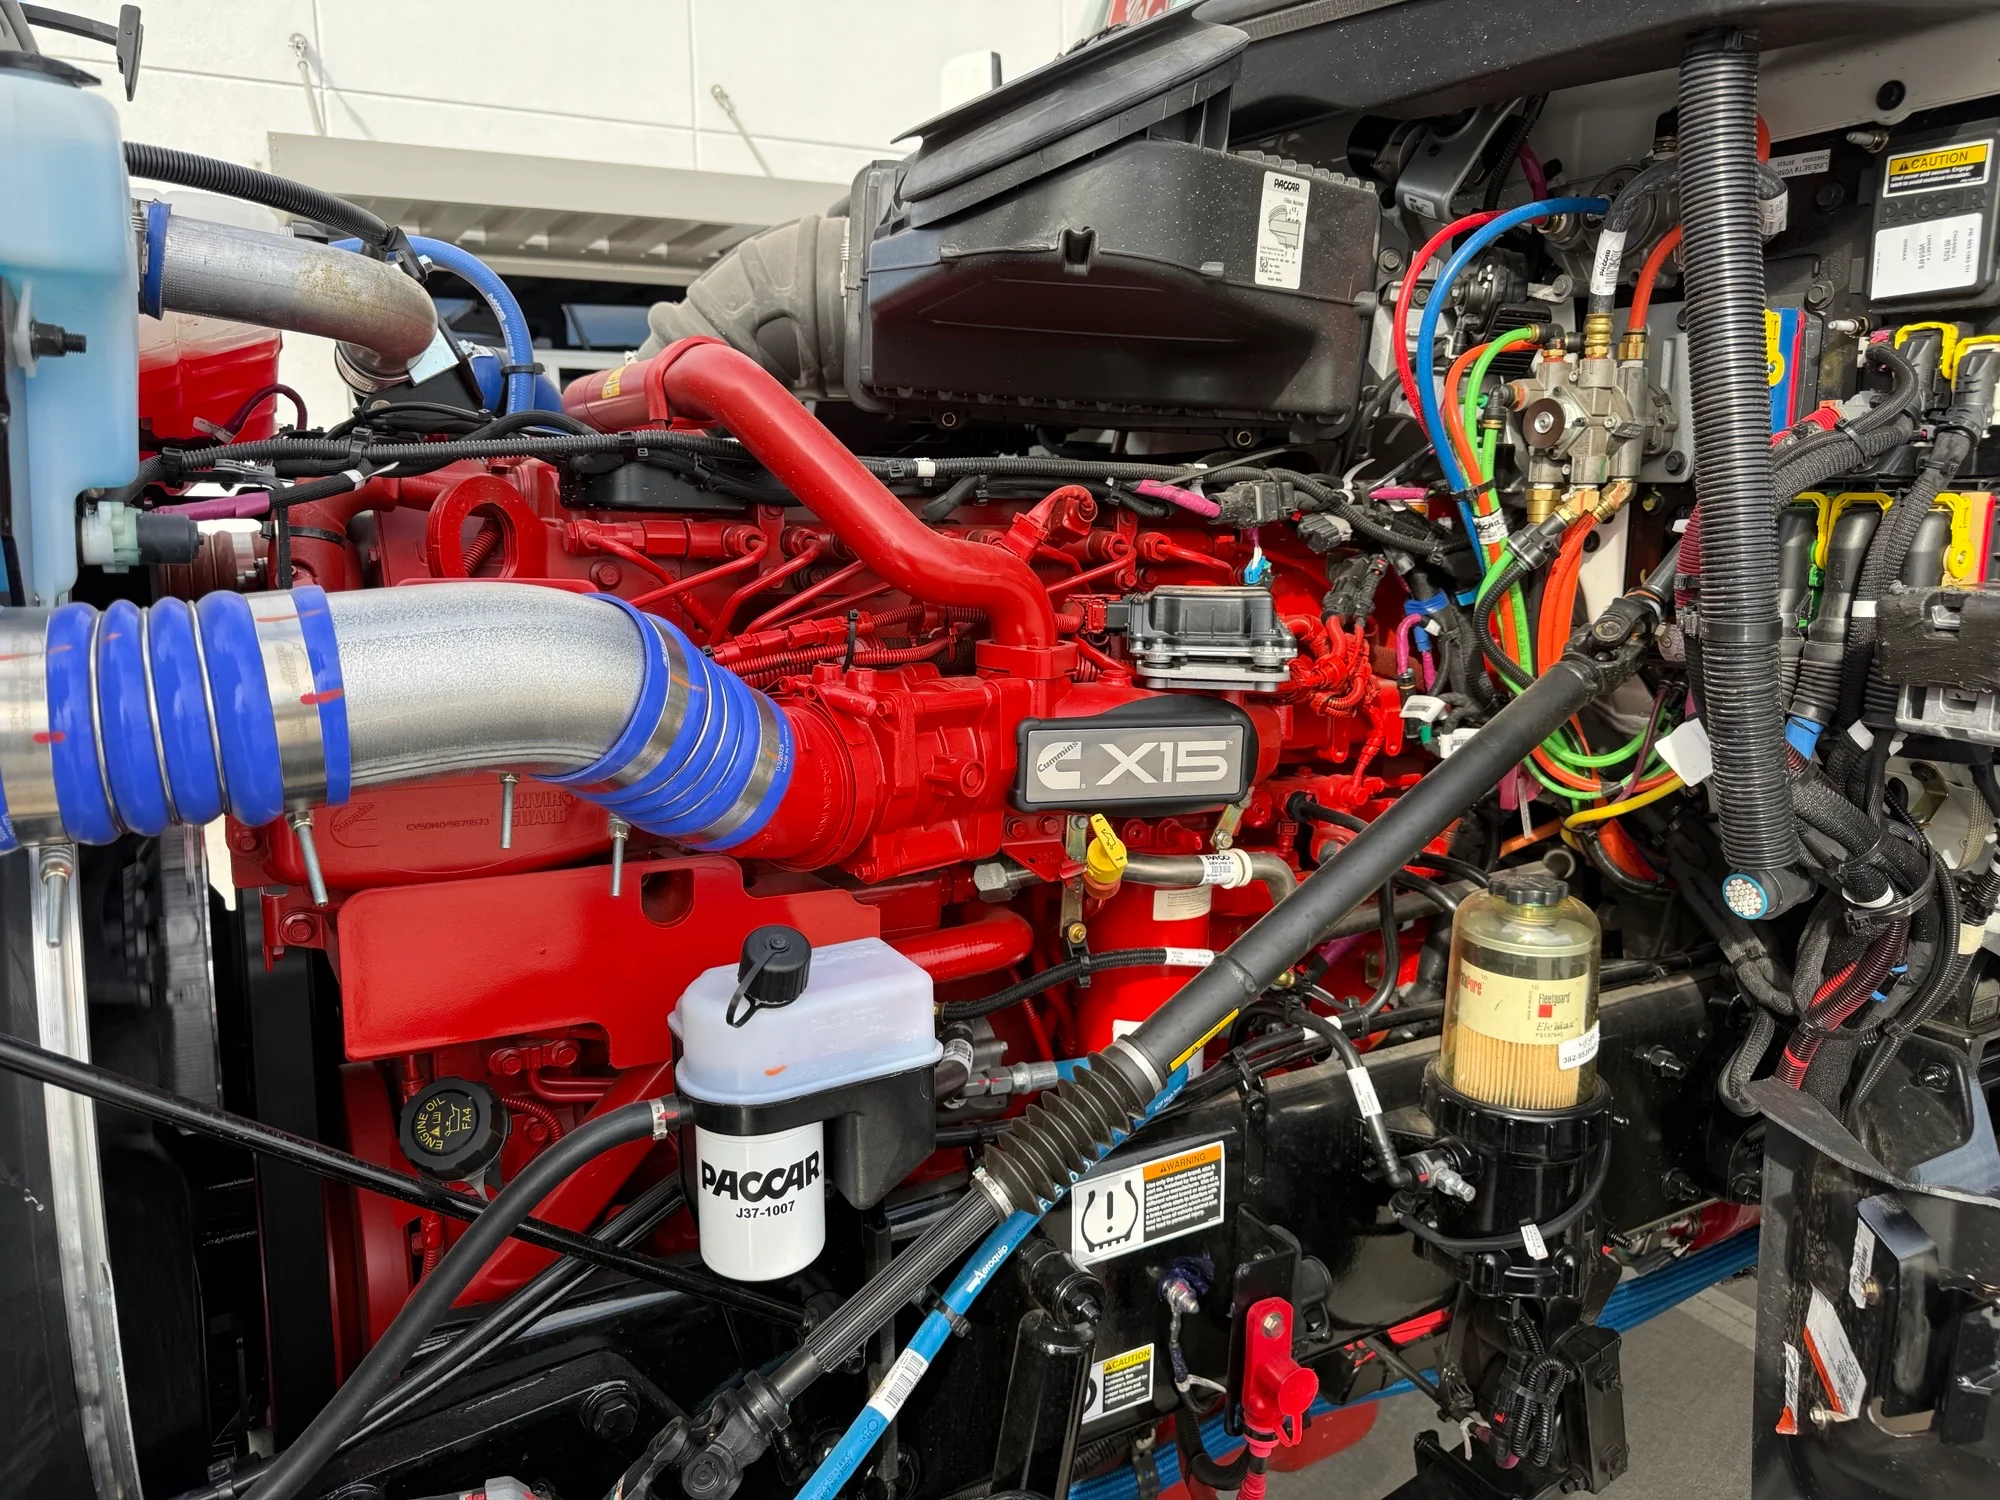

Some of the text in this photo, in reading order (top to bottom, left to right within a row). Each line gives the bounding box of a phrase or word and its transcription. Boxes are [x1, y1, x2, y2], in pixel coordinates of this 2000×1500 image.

[1911, 151, 1968, 169] CAUTION
[1273, 178, 1300, 193] PACCAR
[1880, 188, 1986, 223] PACCAR
[1599, 249, 1611, 276] PACCAR
[775, 743, 785, 772] 03/2025
[1037, 741, 1079, 773] Cummins
[1096, 740, 1228, 786] X15
[333, 803, 376, 833] Cummins
[1538, 992, 1571, 1007] Fleetguard
[417, 1097, 446, 1150] ENGINE OIL
[462, 1107, 472, 1130] FA4
[1167, 1153, 1206, 1171] WARNING
[701, 1150, 820, 1203] PACCAR
[735, 1200, 796, 1219] J37-1007
[969, 1244, 1009, 1288] Aeroquip
[1112, 1349, 1150, 1369] CAUTION
